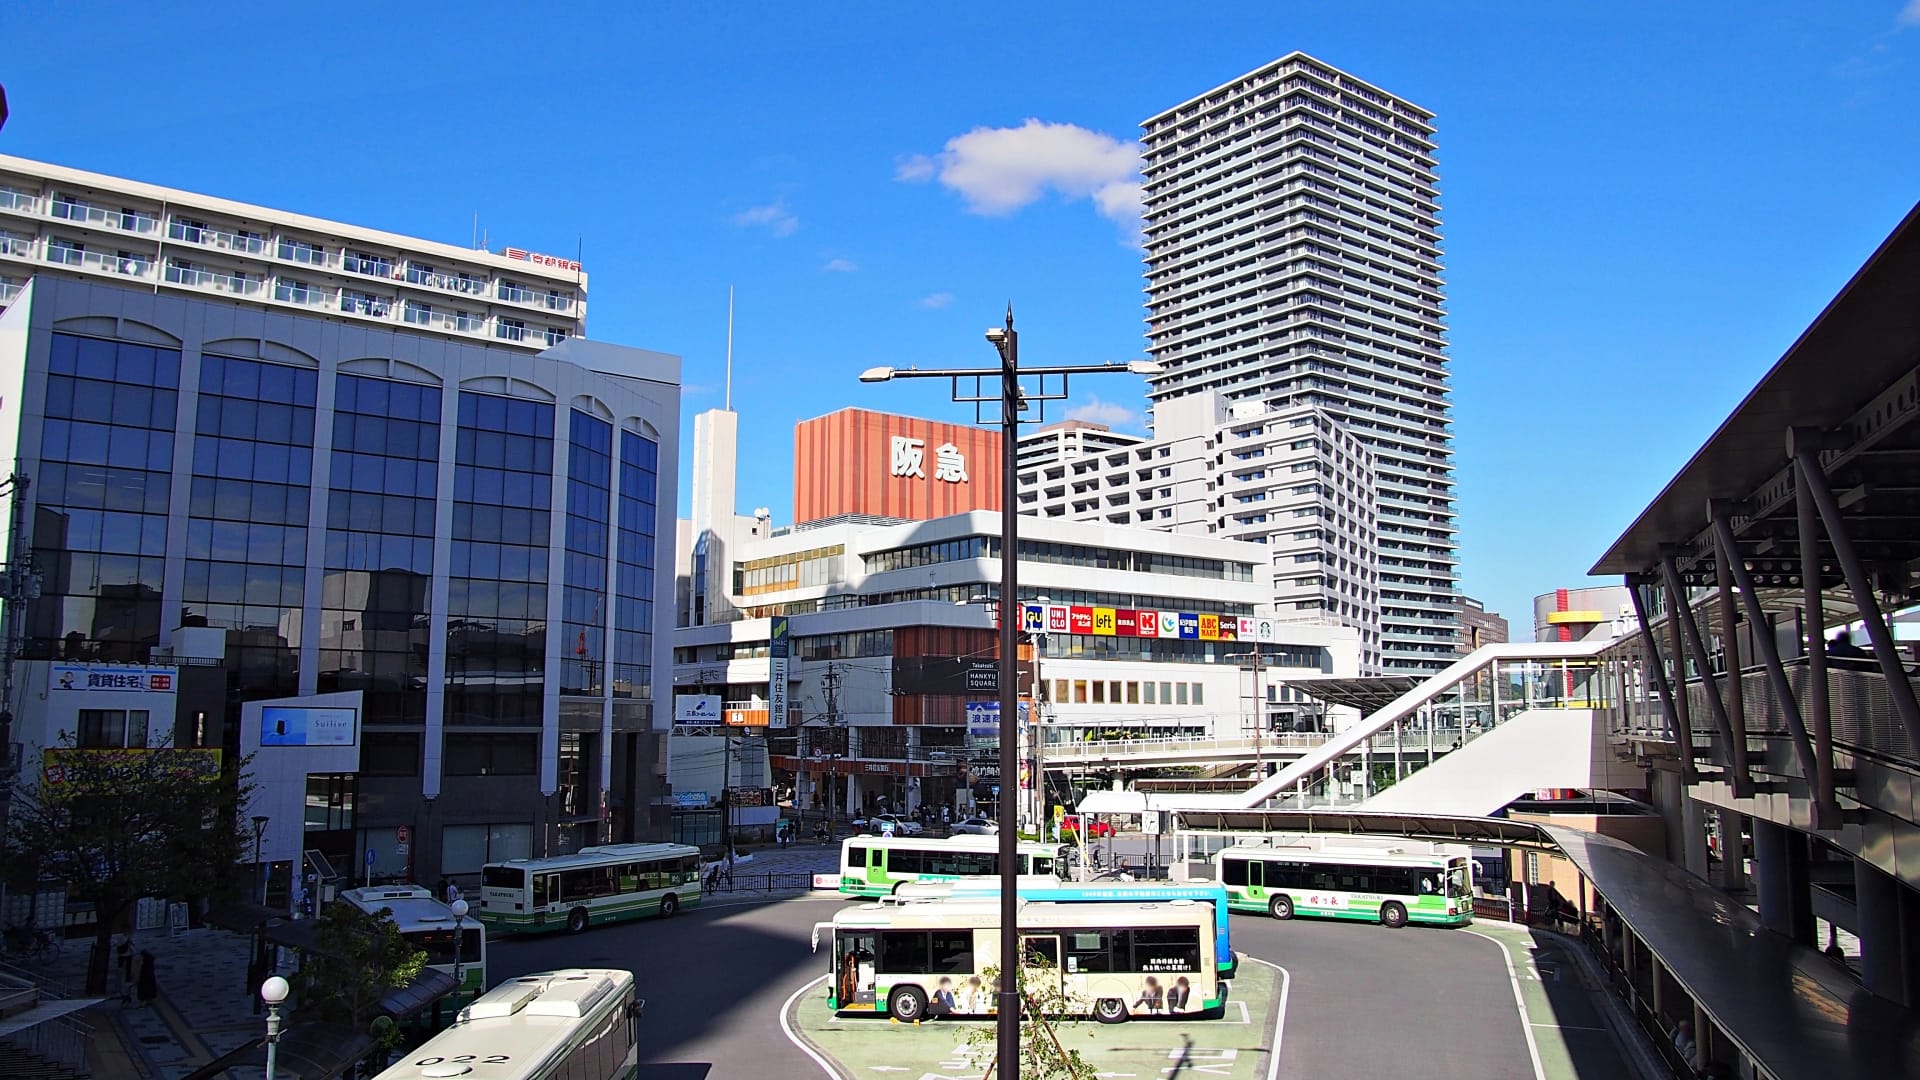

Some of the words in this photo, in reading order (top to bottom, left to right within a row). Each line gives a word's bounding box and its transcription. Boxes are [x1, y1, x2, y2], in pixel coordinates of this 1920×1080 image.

[891, 436, 968, 483] 阪急
[1027, 612, 1042, 622] GU
[1051, 610, 1064, 618] UNI
[1051, 620, 1065, 628] QLO
[1201, 618, 1217, 629] ABC
[1220, 621, 1236, 630] Seria
[1201, 629, 1217, 637] MART
[774, 662, 784, 725] 三井住友銀行
[415, 1055, 510, 1066] 022
